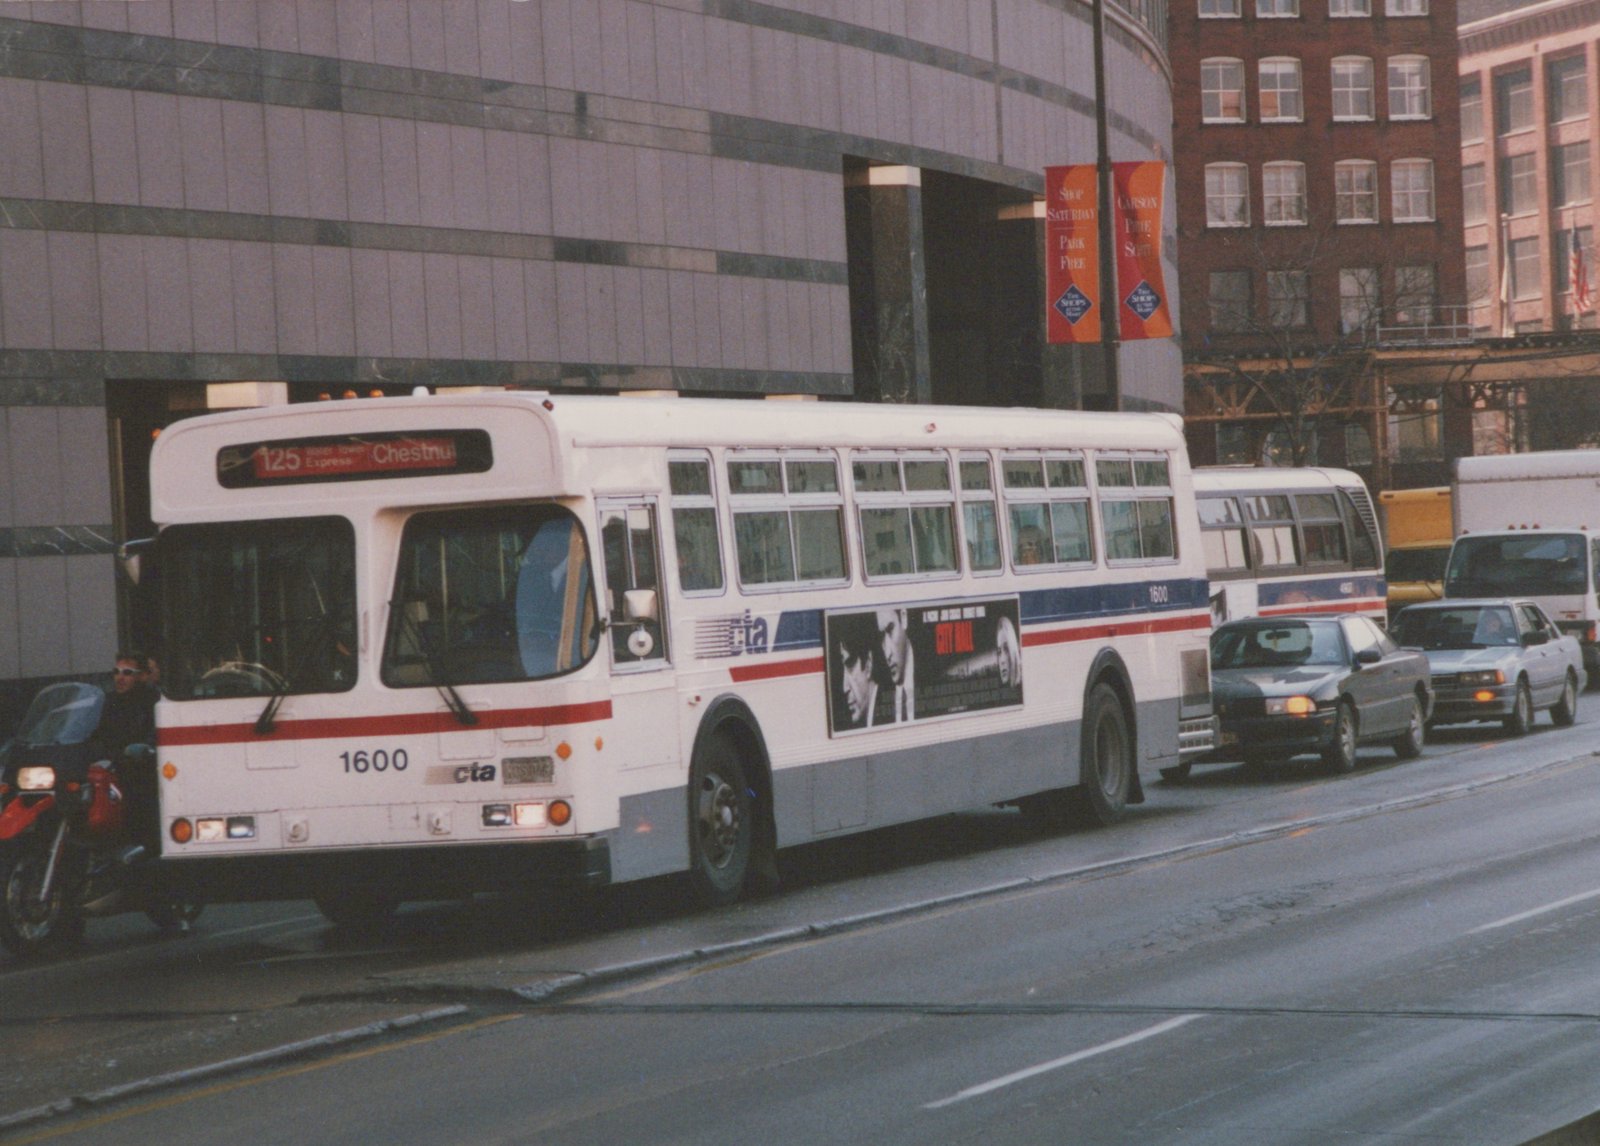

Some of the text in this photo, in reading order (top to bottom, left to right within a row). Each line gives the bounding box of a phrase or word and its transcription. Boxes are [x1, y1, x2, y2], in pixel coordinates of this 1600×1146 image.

[1047, 207, 1096, 220] SATURDAY
[1060, 235, 1085, 249] PARK
[260, 447, 300, 471] 125
[305, 457, 352, 468] Express
[1149, 585, 1168, 603] 1600
[339, 748, 408, 774] 1600
[453, 762, 497, 783] cta
